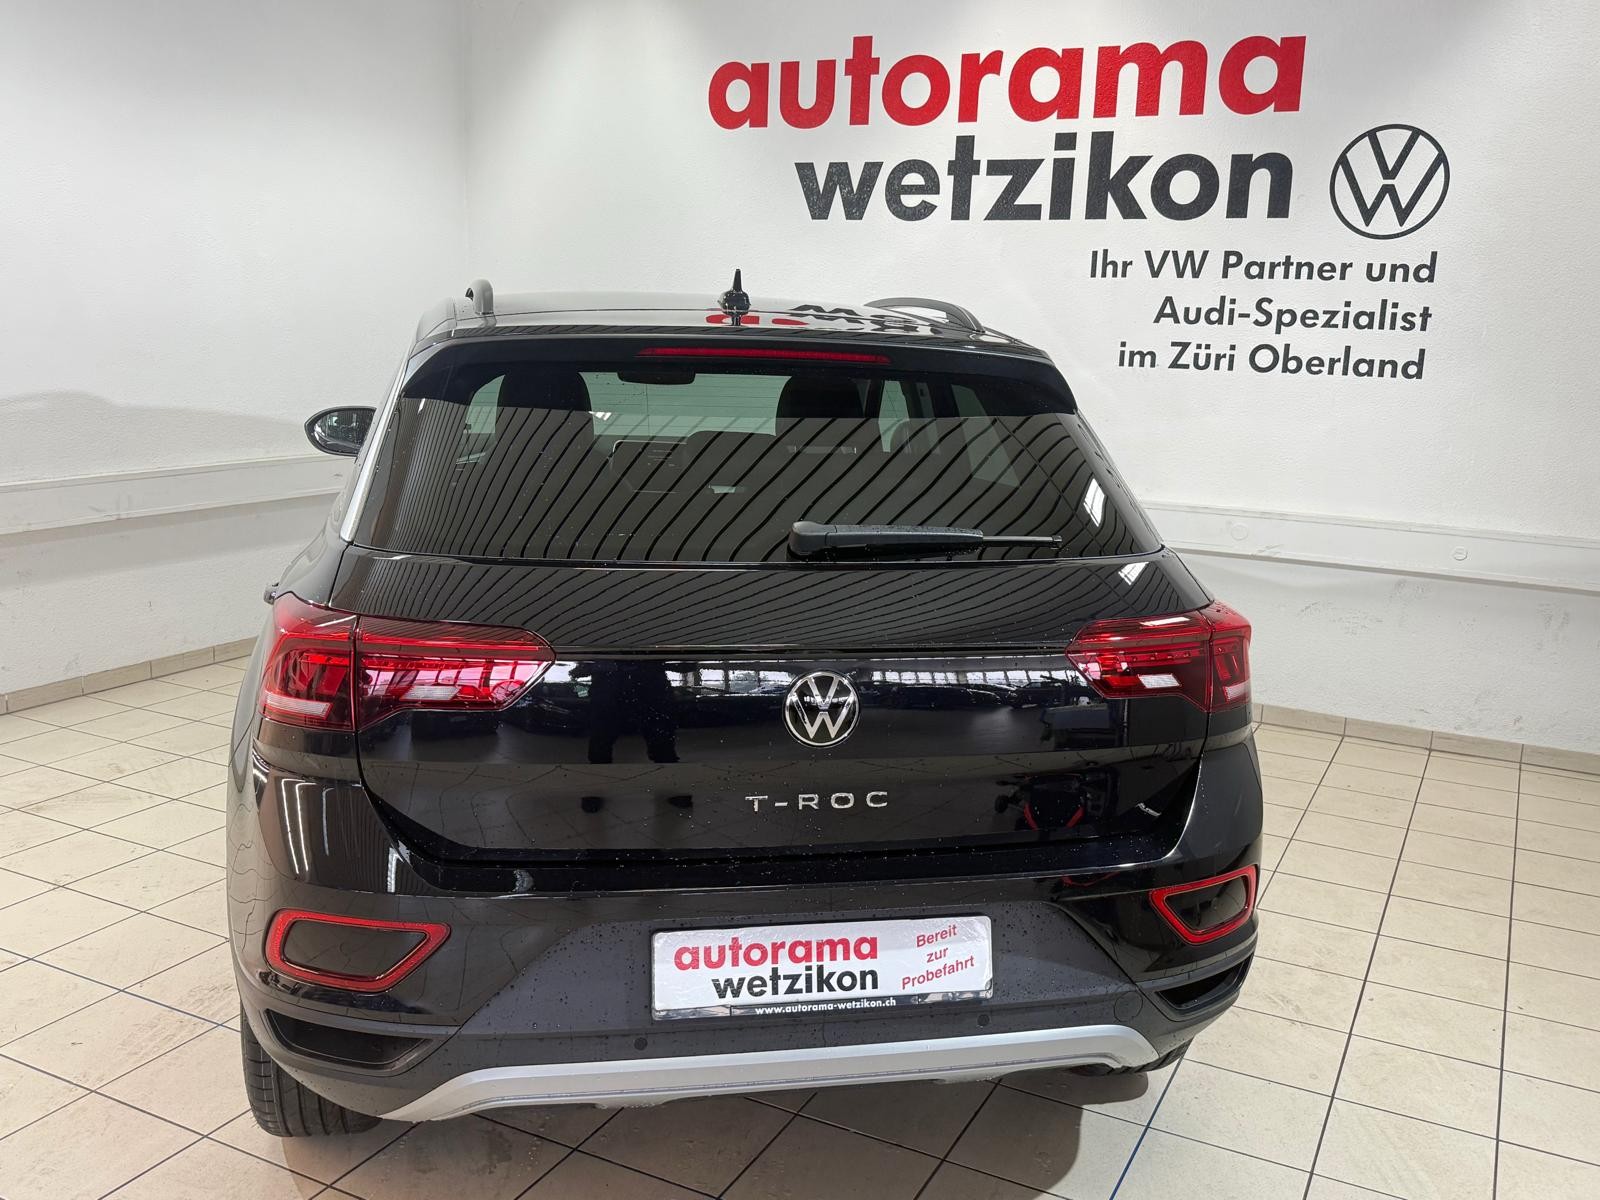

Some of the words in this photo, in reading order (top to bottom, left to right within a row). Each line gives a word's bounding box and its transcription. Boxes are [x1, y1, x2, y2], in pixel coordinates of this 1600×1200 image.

[708, 36, 1307, 129] autorama
[795, 131, 1293, 221] wetzikon
[1090, 249, 1133, 278] Ihr
[1144, 250, 1210, 279] VW
[1221, 250, 1354, 281] Partner
[1365, 251, 1438, 283] und
[1153, 295, 1433, 335] Audi-Spezialist
[1118, 341, 1157, 368] im
[1168, 341, 1236, 372] Züri
[1248, 343, 1426, 380] Oberland
[745, 791, 888, 812] T-ROC
[916, 924, 958, 948] Bereit
[673, 936, 879, 972] autorama
[926, 945, 949, 963] zur
[711, 964, 879, 999] wetzikon
[901, 955, 975, 990] Probefahrt
[755, 997, 897, 1015] www.autorama-wetzikon.ch
